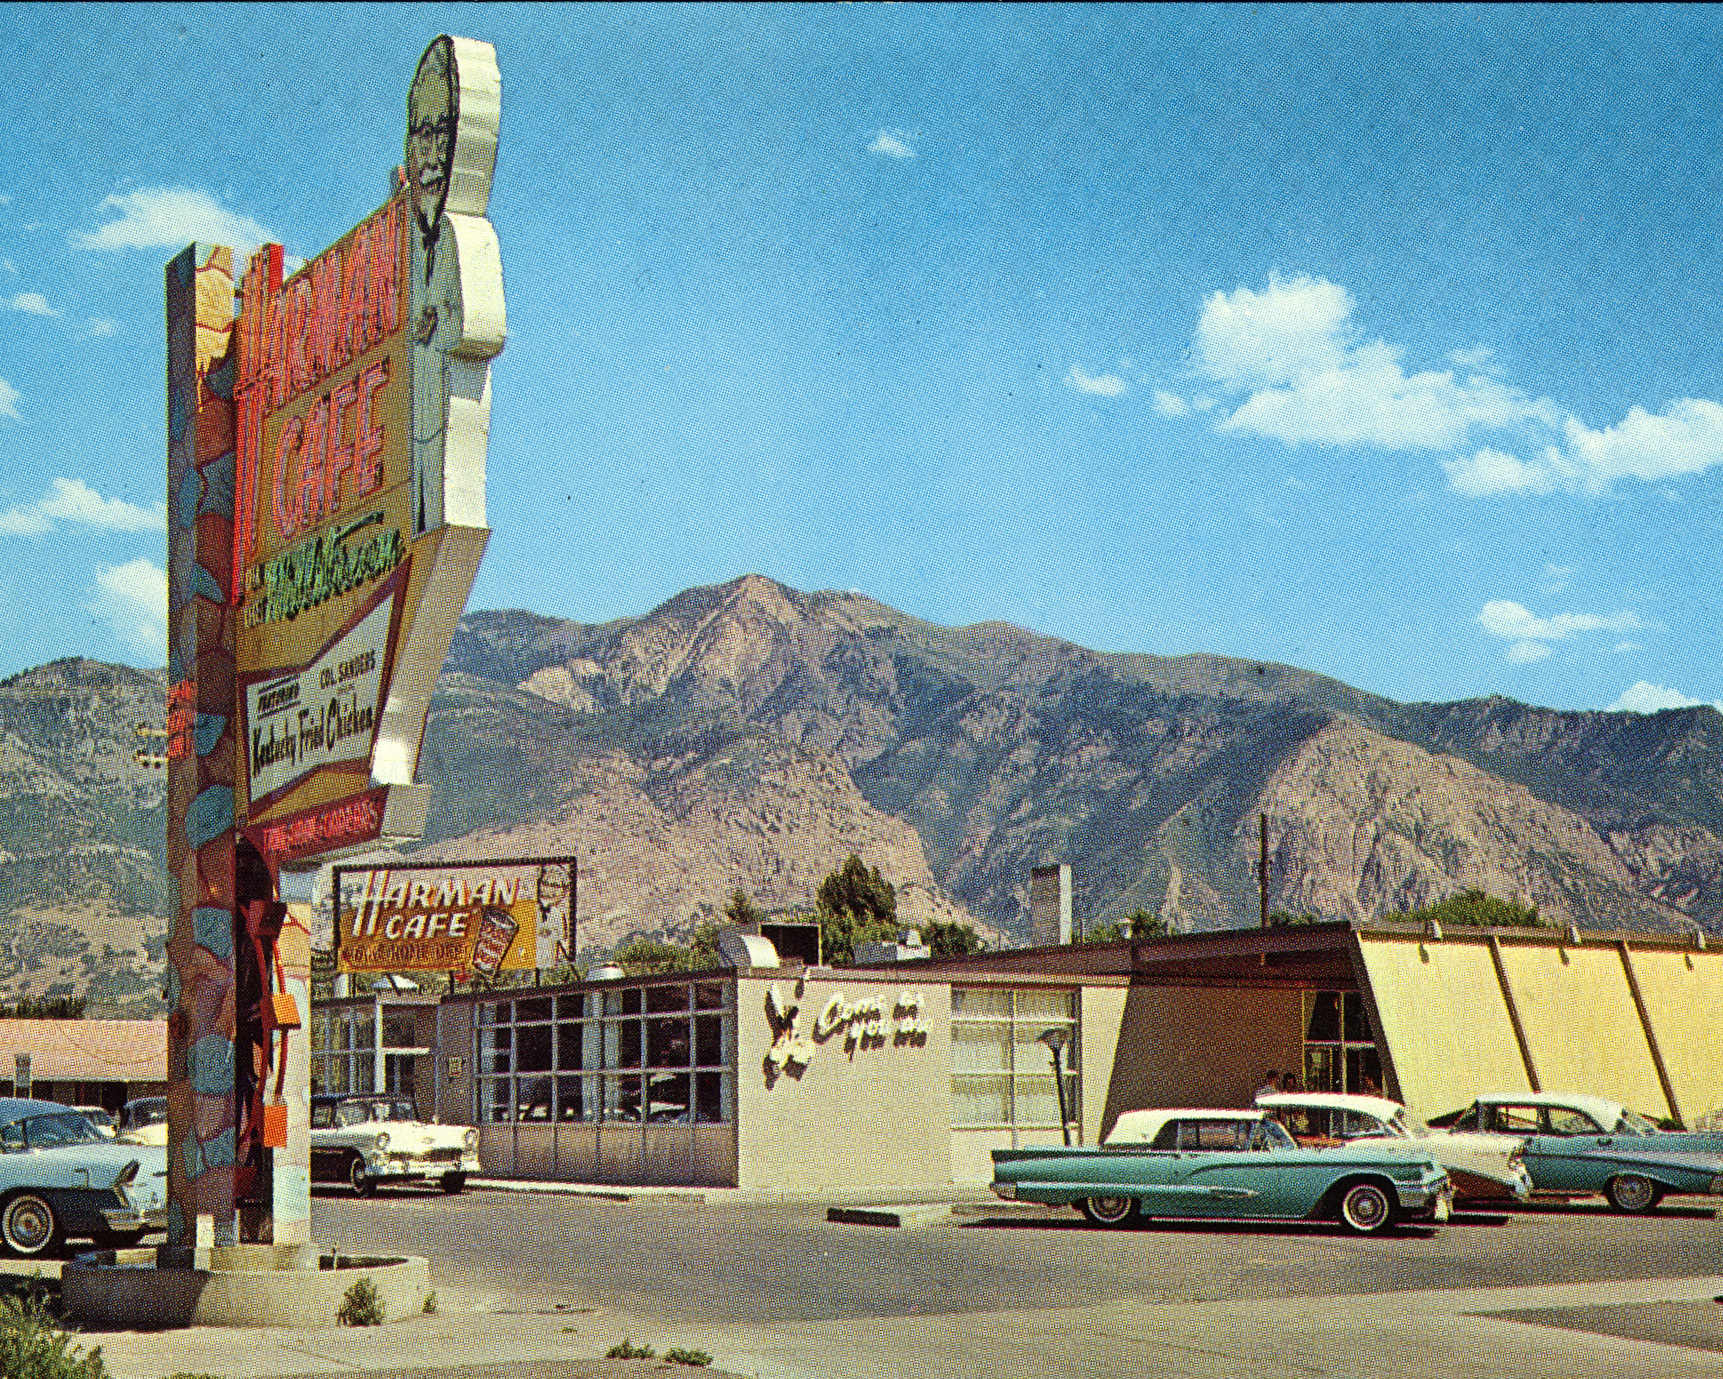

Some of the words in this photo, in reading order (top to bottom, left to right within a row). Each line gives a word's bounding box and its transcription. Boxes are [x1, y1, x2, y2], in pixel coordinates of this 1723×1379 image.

[272, 356, 391, 541] CAFE
[338, 649, 375, 684] SANDERS
[252, 716, 296, 779] Kentucky
[298, 704, 326, 764] Fried
[326, 692, 374, 752] Chicken
[352, 869, 520, 937] HARMAN
[385, 912, 469, 940] CAFE
